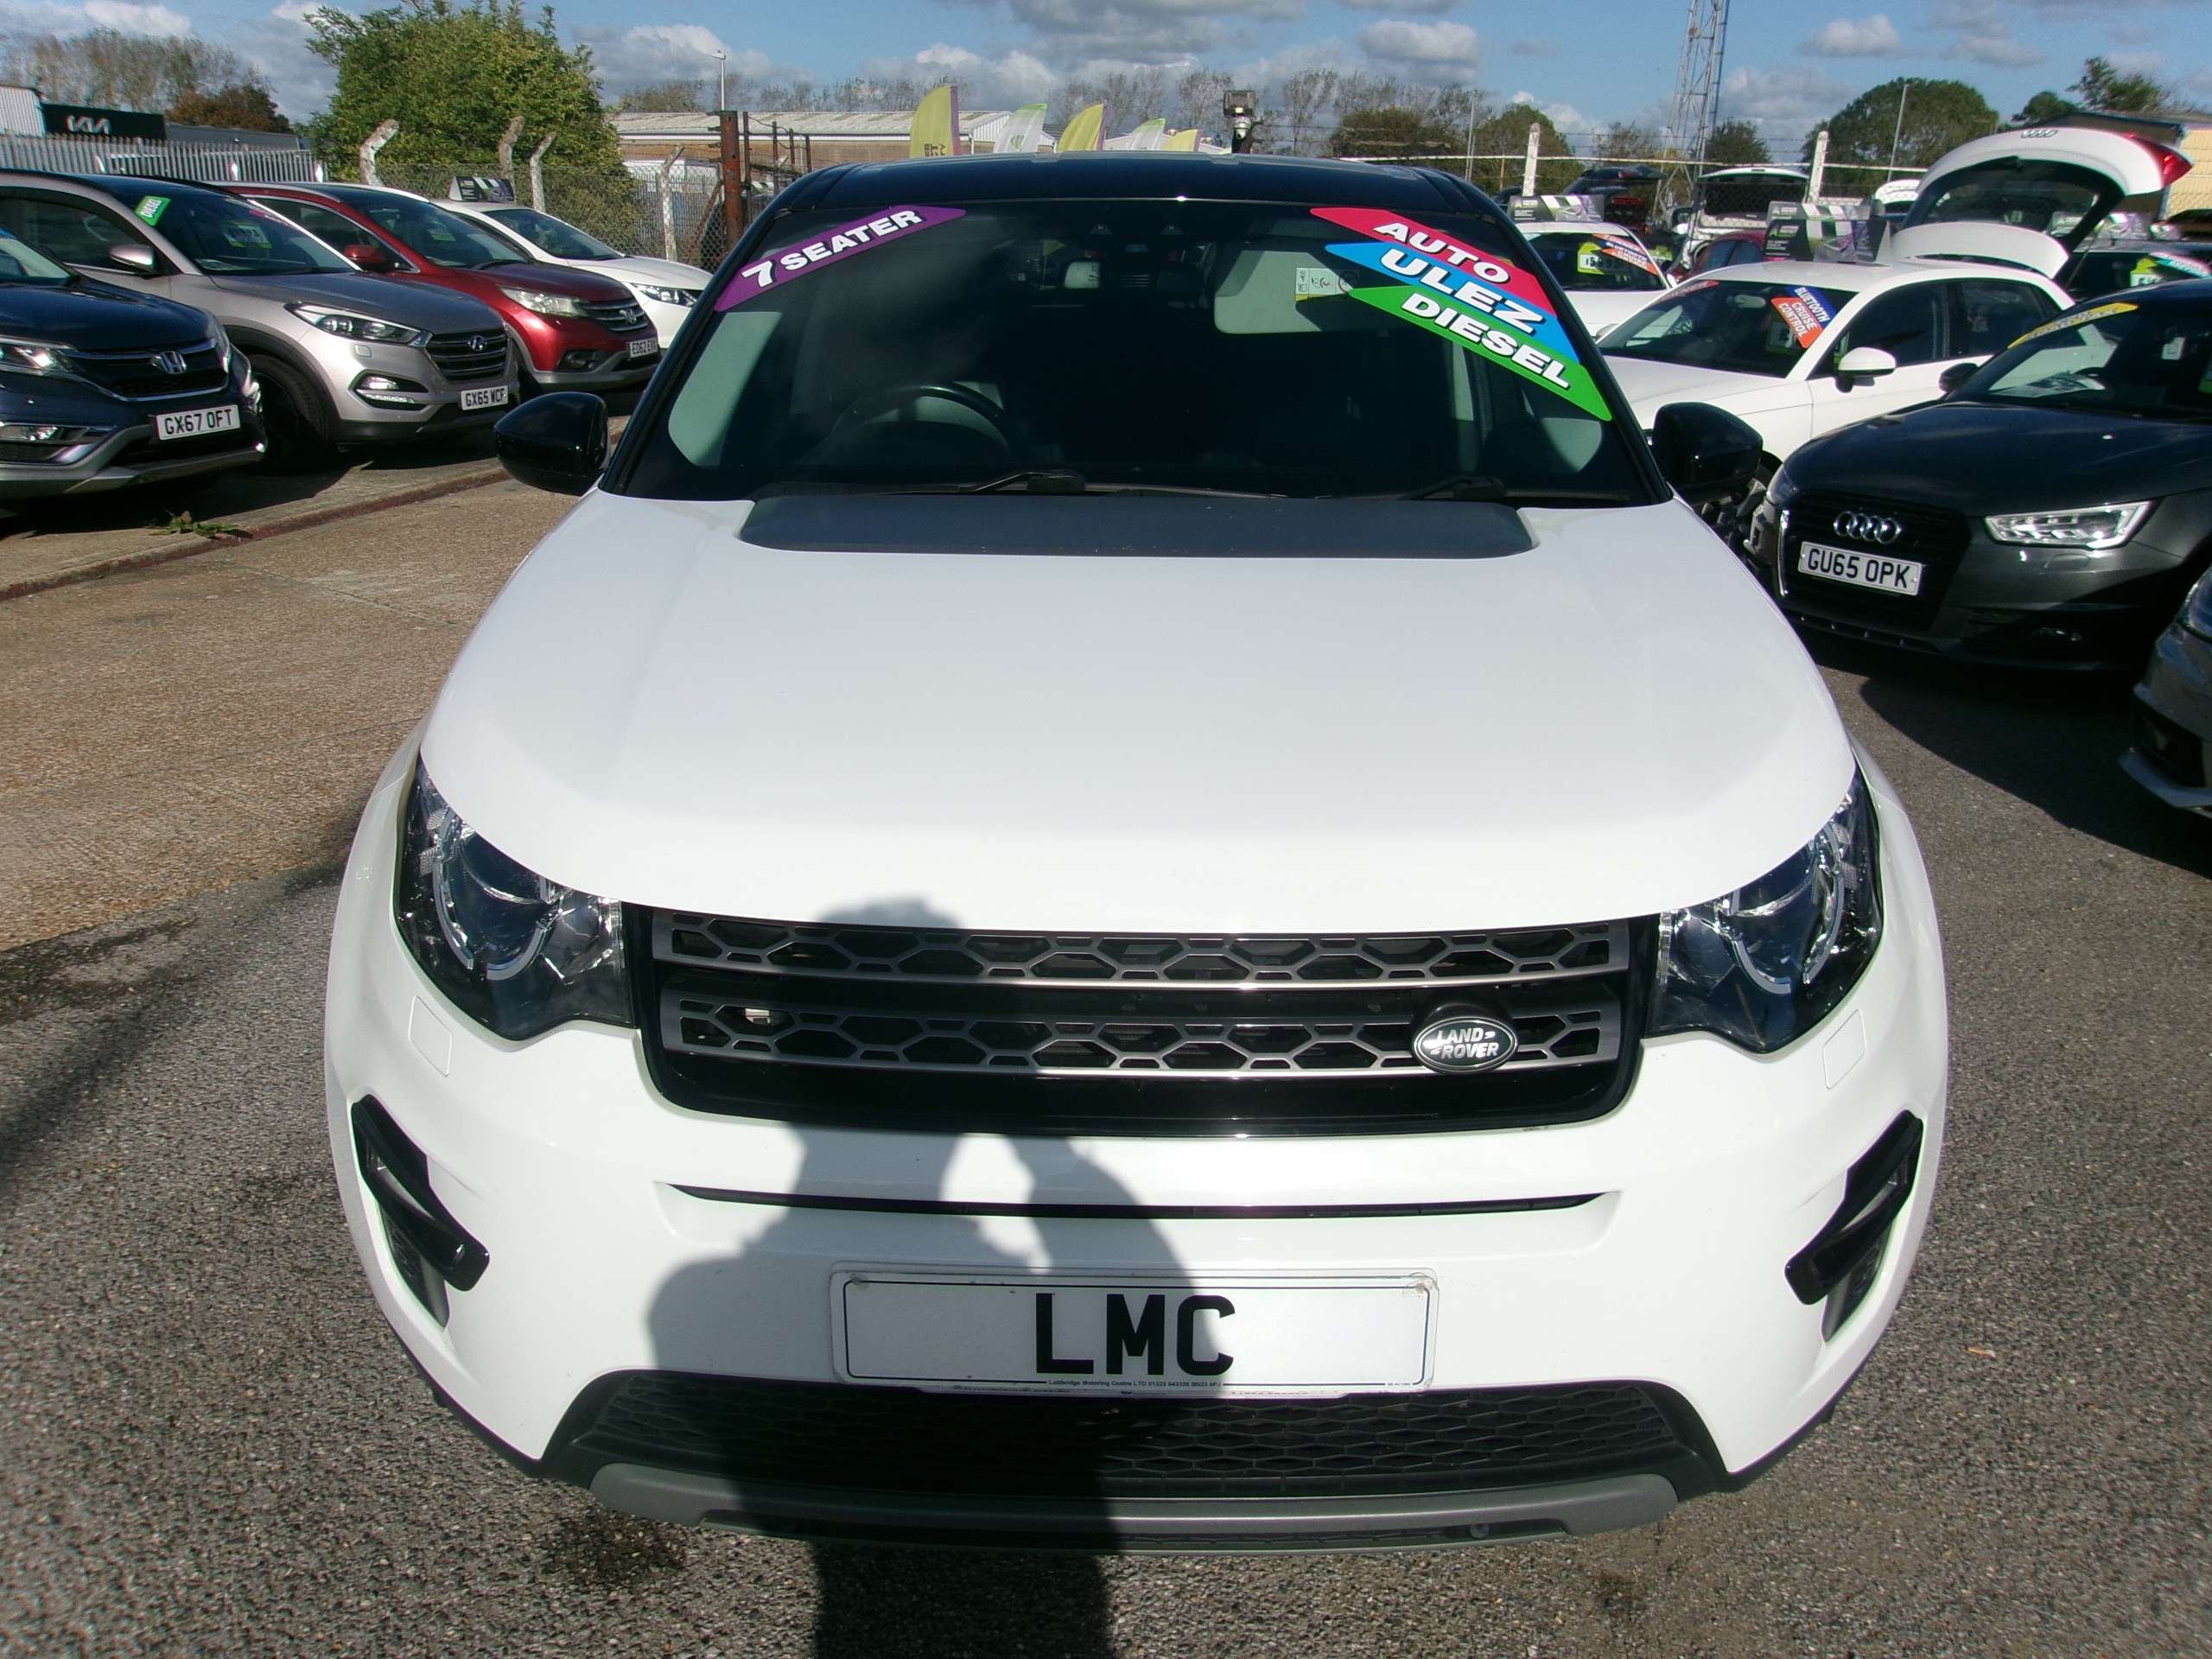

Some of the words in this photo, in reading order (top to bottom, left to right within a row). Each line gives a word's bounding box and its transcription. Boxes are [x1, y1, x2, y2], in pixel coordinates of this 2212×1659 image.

[741, 260, 773, 288] 7
[780, 210, 923, 270] SEATER
[1373, 222, 1510, 284] AUTO
[1380, 248, 1545, 335] ULEZ
[1794, 287, 1831, 322] BLUETOOTH
[1778, 302, 1808, 337] CONTROL
[1792, 302, 1817, 331] CRUISE
[1401, 292, 1571, 390] DIESEL
[164, 414, 202, 435] GX67
[207, 409, 232, 429] OFT
[1808, 548, 1860, 579] GU65
[1865, 559, 1910, 588] OPK
[1436, 1027, 1484, 1044] LAND
[1440, 1042, 1499, 1059] ROVER
[1037, 1293, 1236, 1376] LMC
